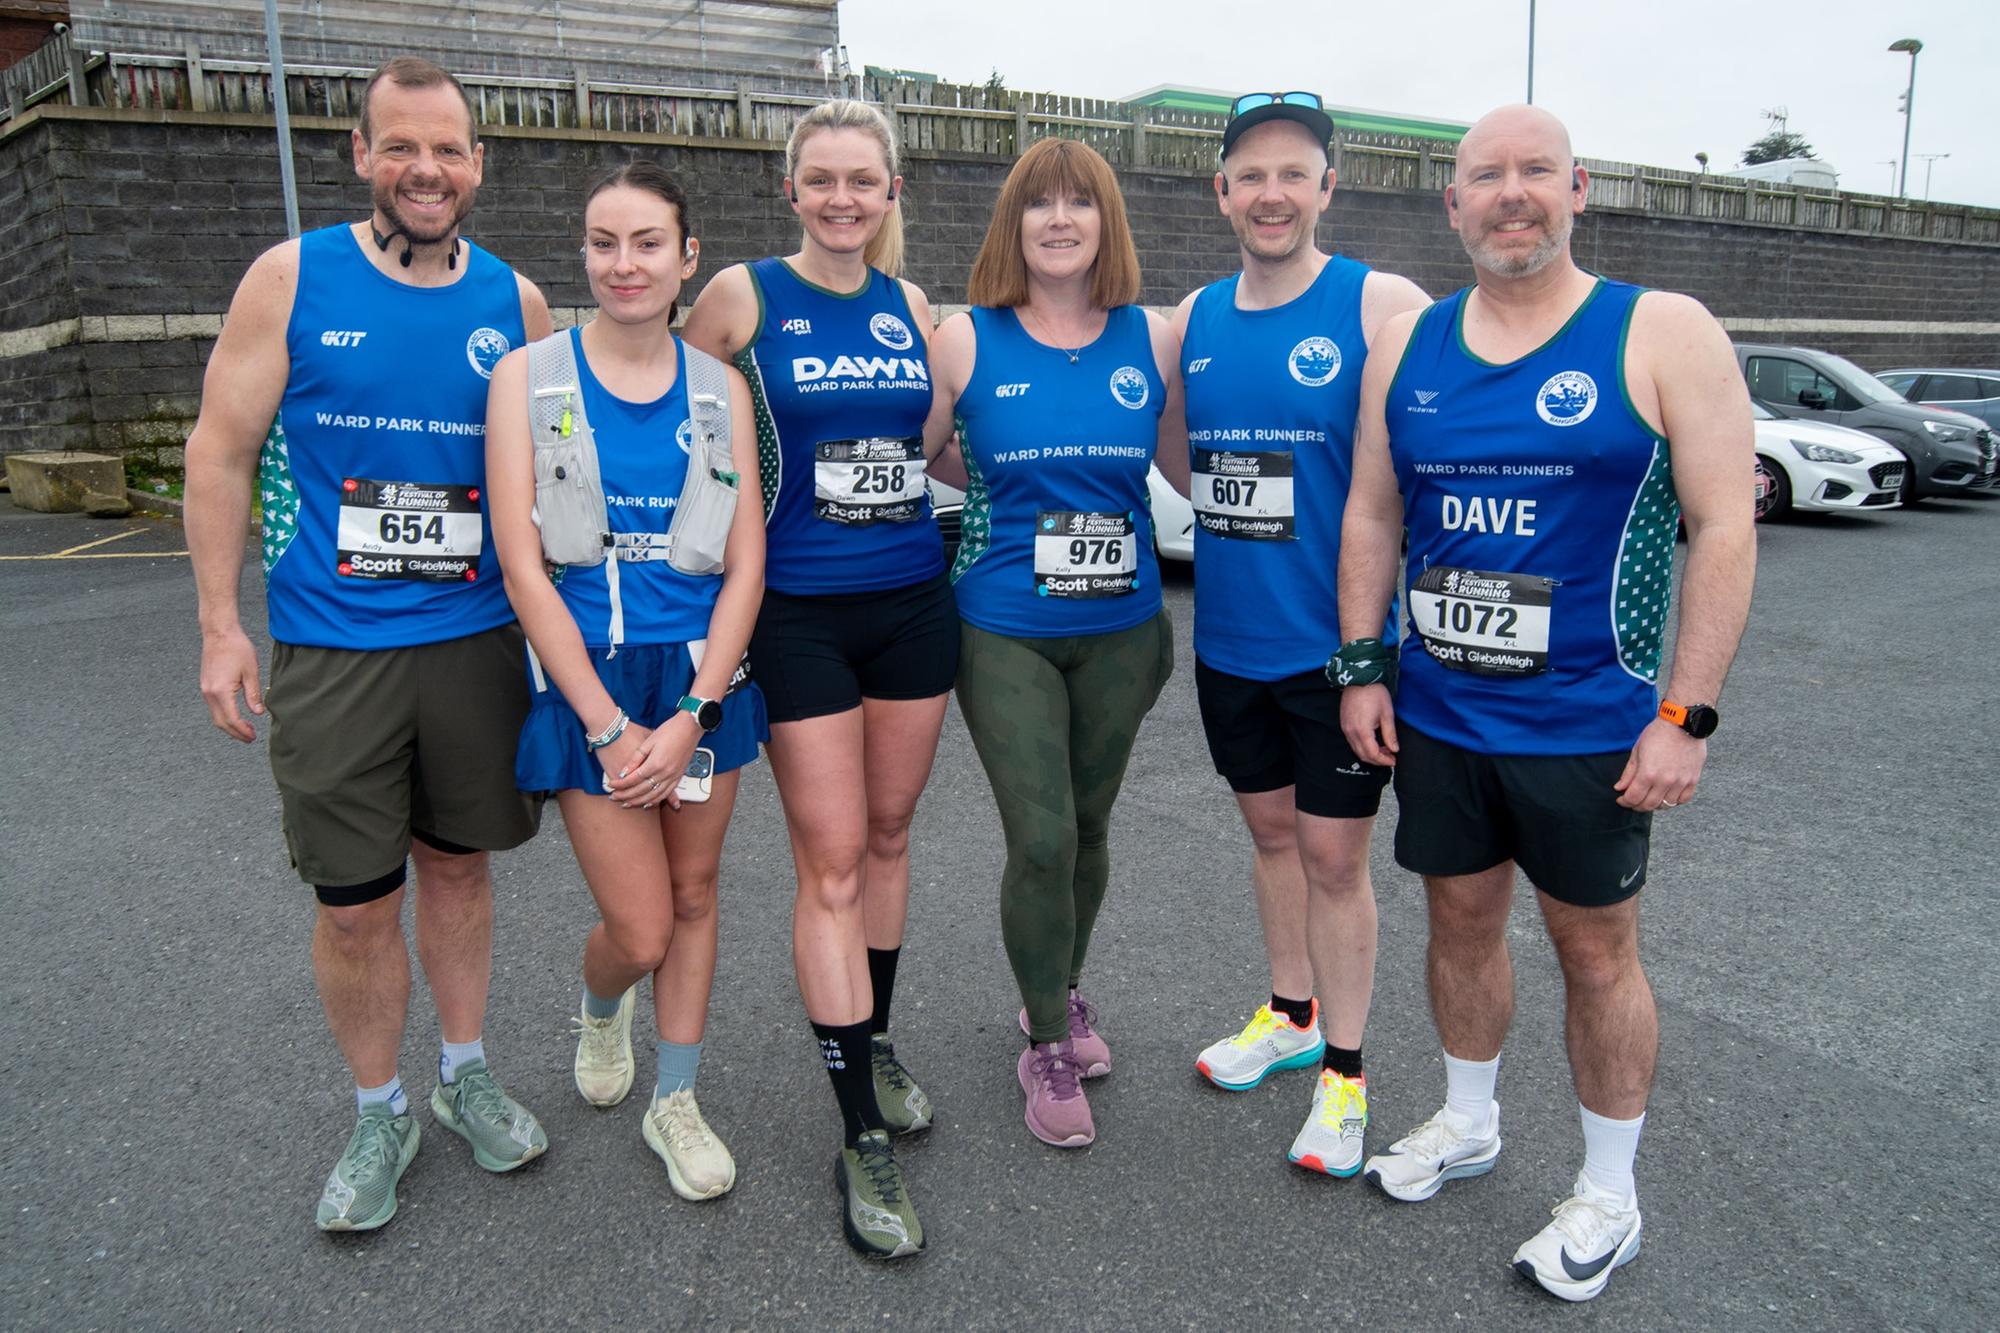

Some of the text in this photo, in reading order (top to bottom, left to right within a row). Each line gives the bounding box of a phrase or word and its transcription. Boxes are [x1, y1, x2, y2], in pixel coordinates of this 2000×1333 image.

[792, 355, 928, 382] DAWN
[798, 380, 929, 393] WARD PARK RUNNERS
[316, 412, 370, 429] WARD
[376, 417, 423, 432] PARK
[1214, 429, 1251, 440] PARK
[1255, 429, 1325, 443] RUNNERS
[868, 449, 907, 459] RUNNING
[994, 445, 1146, 464] WARD PARK RUNNERS
[1221, 465, 1260, 473] RUNNING
[1414, 463, 1574, 476] WARD PARK RUNNERS
[852, 465, 905, 494] 258
[399, 490, 447, 499] FESTIVAL OF
[1212, 478, 1258, 507] 607
[397, 497, 449, 507] RUNNING
[606, 495, 645, 508] PARK
[827, 502, 872, 520] Scott
[1442, 494, 1537, 536] DAVE
[379, 513, 445, 544] 654
[1084, 525, 1126, 533] RUNNING
[1086, 518, 1114, 526] FESTIVAL
[1200, 514, 1230, 531] Scott
[1069, 539, 1122, 566] 976
[350, 554, 403, 574] Scott
[1045, 577, 1088, 591] Scott
[1460, 579, 1495, 589] FESTIVAL
[1458, 586, 1511, 599] RUNNING
[1433, 598, 1518, 639] 1072
[1428, 628, 1447, 638] David
[1424, 638, 1464, 663] Scott
[1467, 650, 1534, 669] GlobeWeigh
